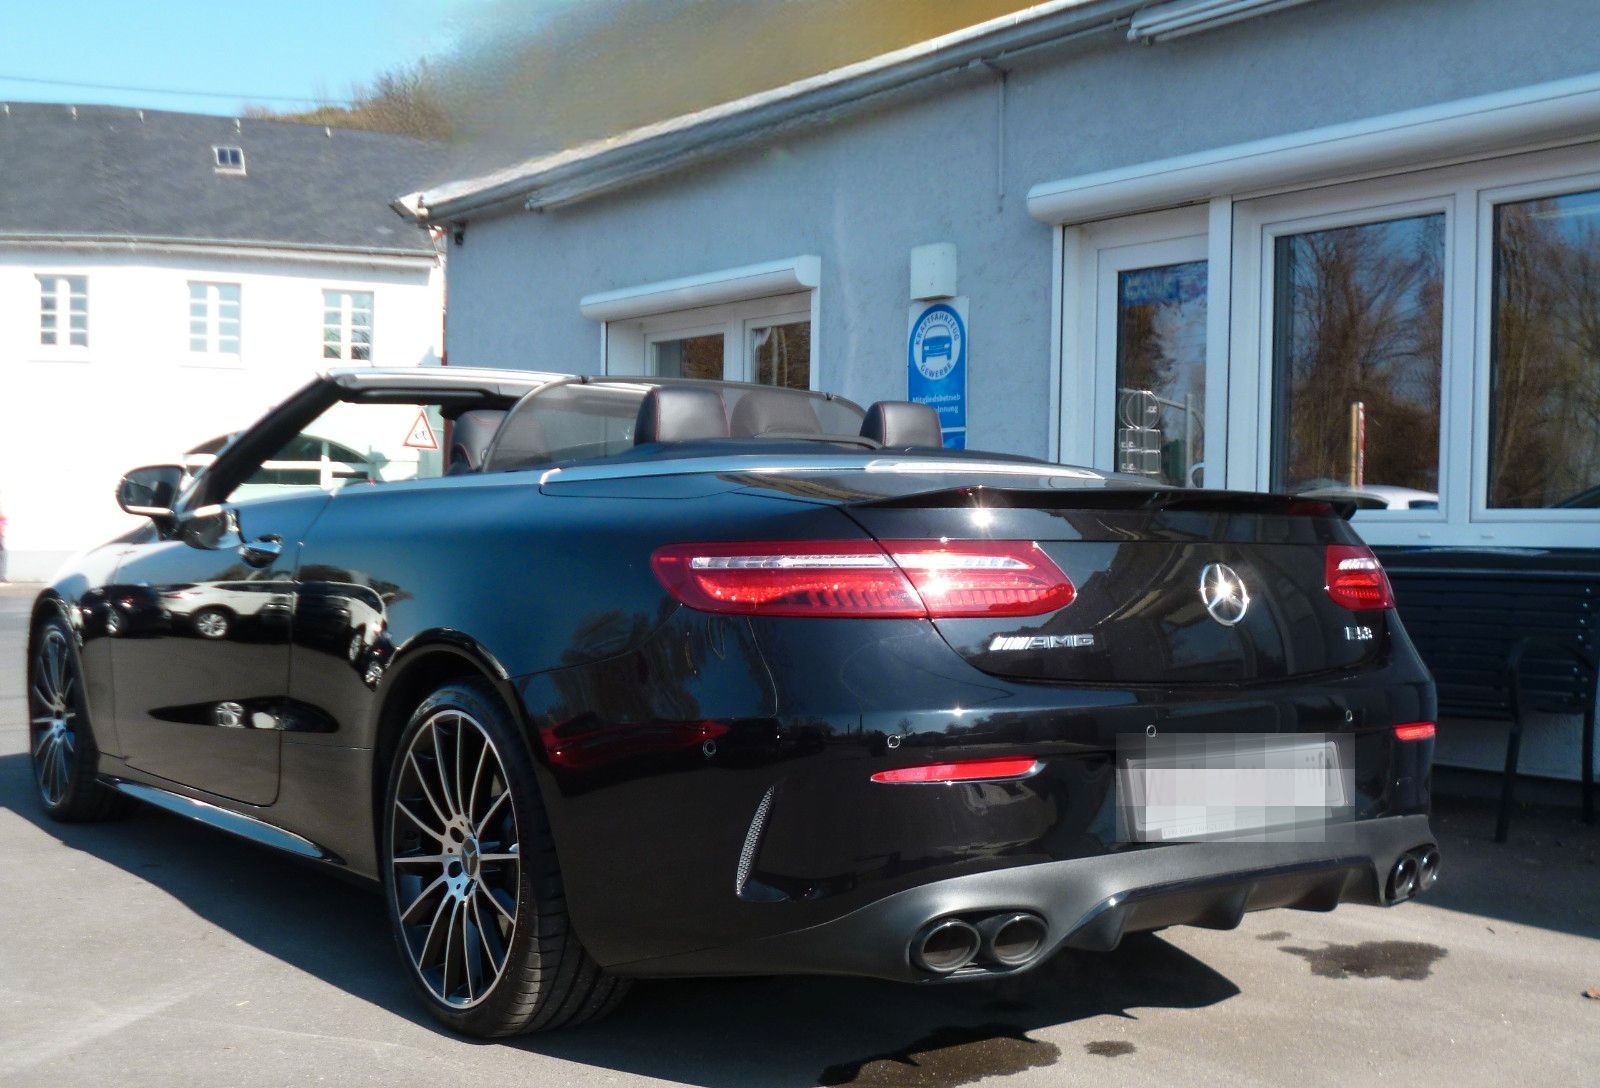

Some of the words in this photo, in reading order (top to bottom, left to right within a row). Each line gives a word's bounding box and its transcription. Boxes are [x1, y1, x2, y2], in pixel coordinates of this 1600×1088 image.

[915, 313, 960, 345] KRAFTFAHRZEUG
[920, 362, 953, 378] GEWERBE
[912, 393, 961, 405] Mitgliedsbetrieb
[1024, 633, 1095, 650] AMG
